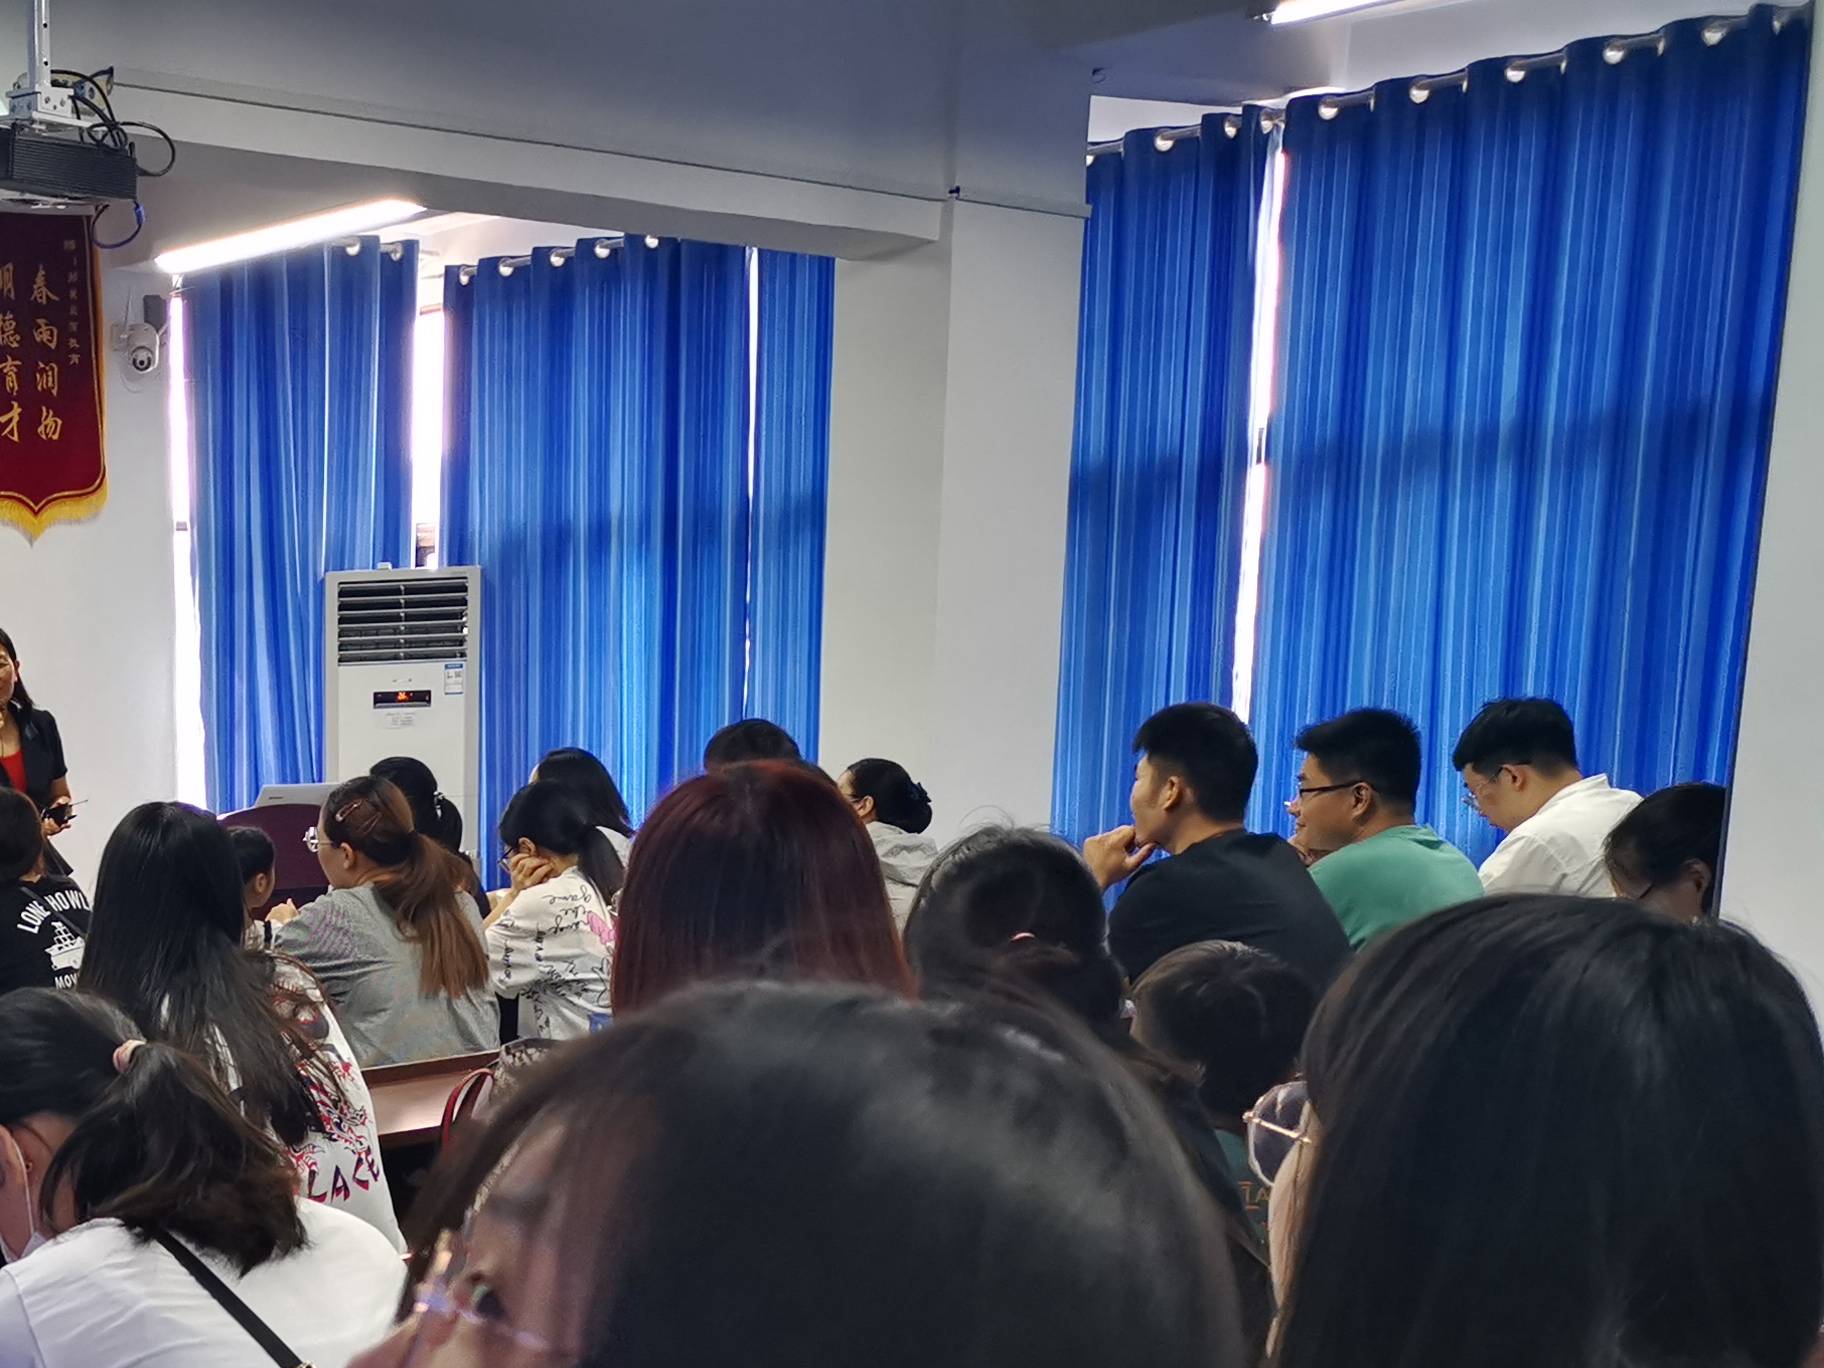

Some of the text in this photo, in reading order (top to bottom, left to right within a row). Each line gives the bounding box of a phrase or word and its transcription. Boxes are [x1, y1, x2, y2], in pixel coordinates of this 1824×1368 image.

[30, 263, 63, 441] 春雨润物
[17, 900, 51, 934] LONE
